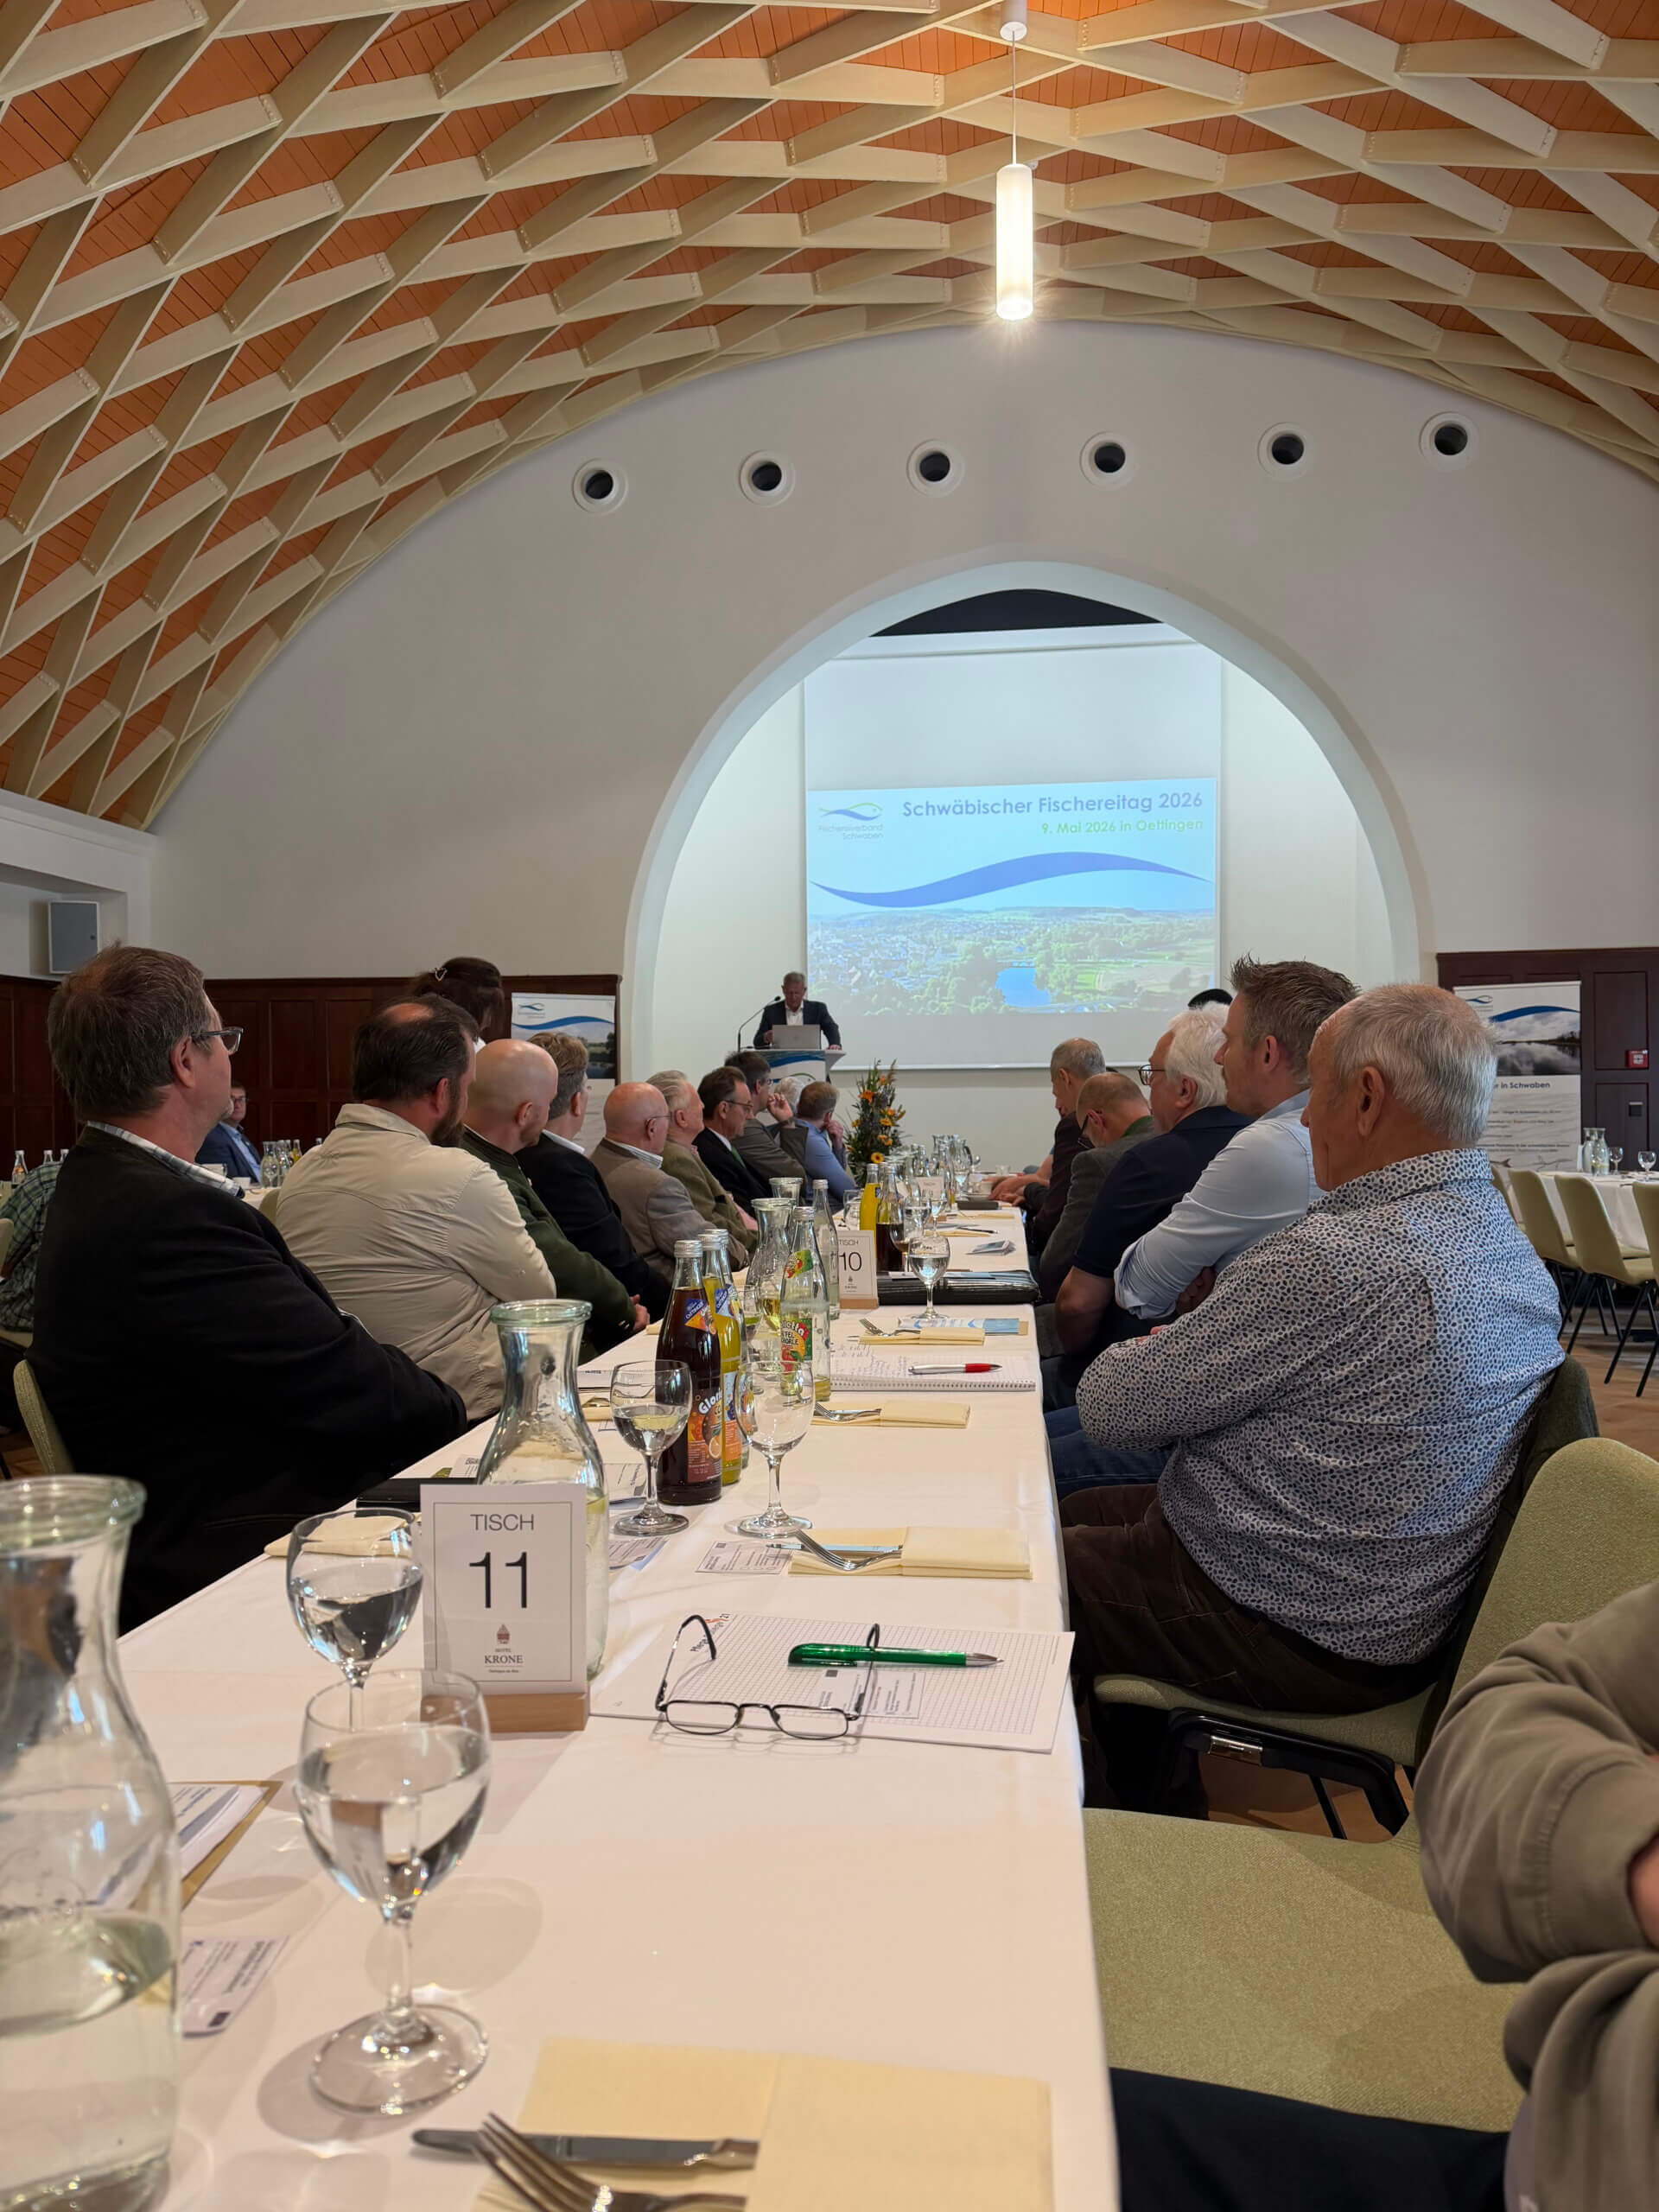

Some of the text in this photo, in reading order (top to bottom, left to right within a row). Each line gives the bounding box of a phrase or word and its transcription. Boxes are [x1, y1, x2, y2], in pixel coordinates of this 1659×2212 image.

[903, 792, 1203, 817] Schwäbischer Fischereitag 2026
[1041, 818, 1204, 834] 9. Mai 2026 in Oettingen
[839, 1251, 862, 1272] 10
[470, 1514, 534, 1531] TISCH
[469, 1552, 527, 1608] 11
[484, 1655, 524, 1663] KRONE
